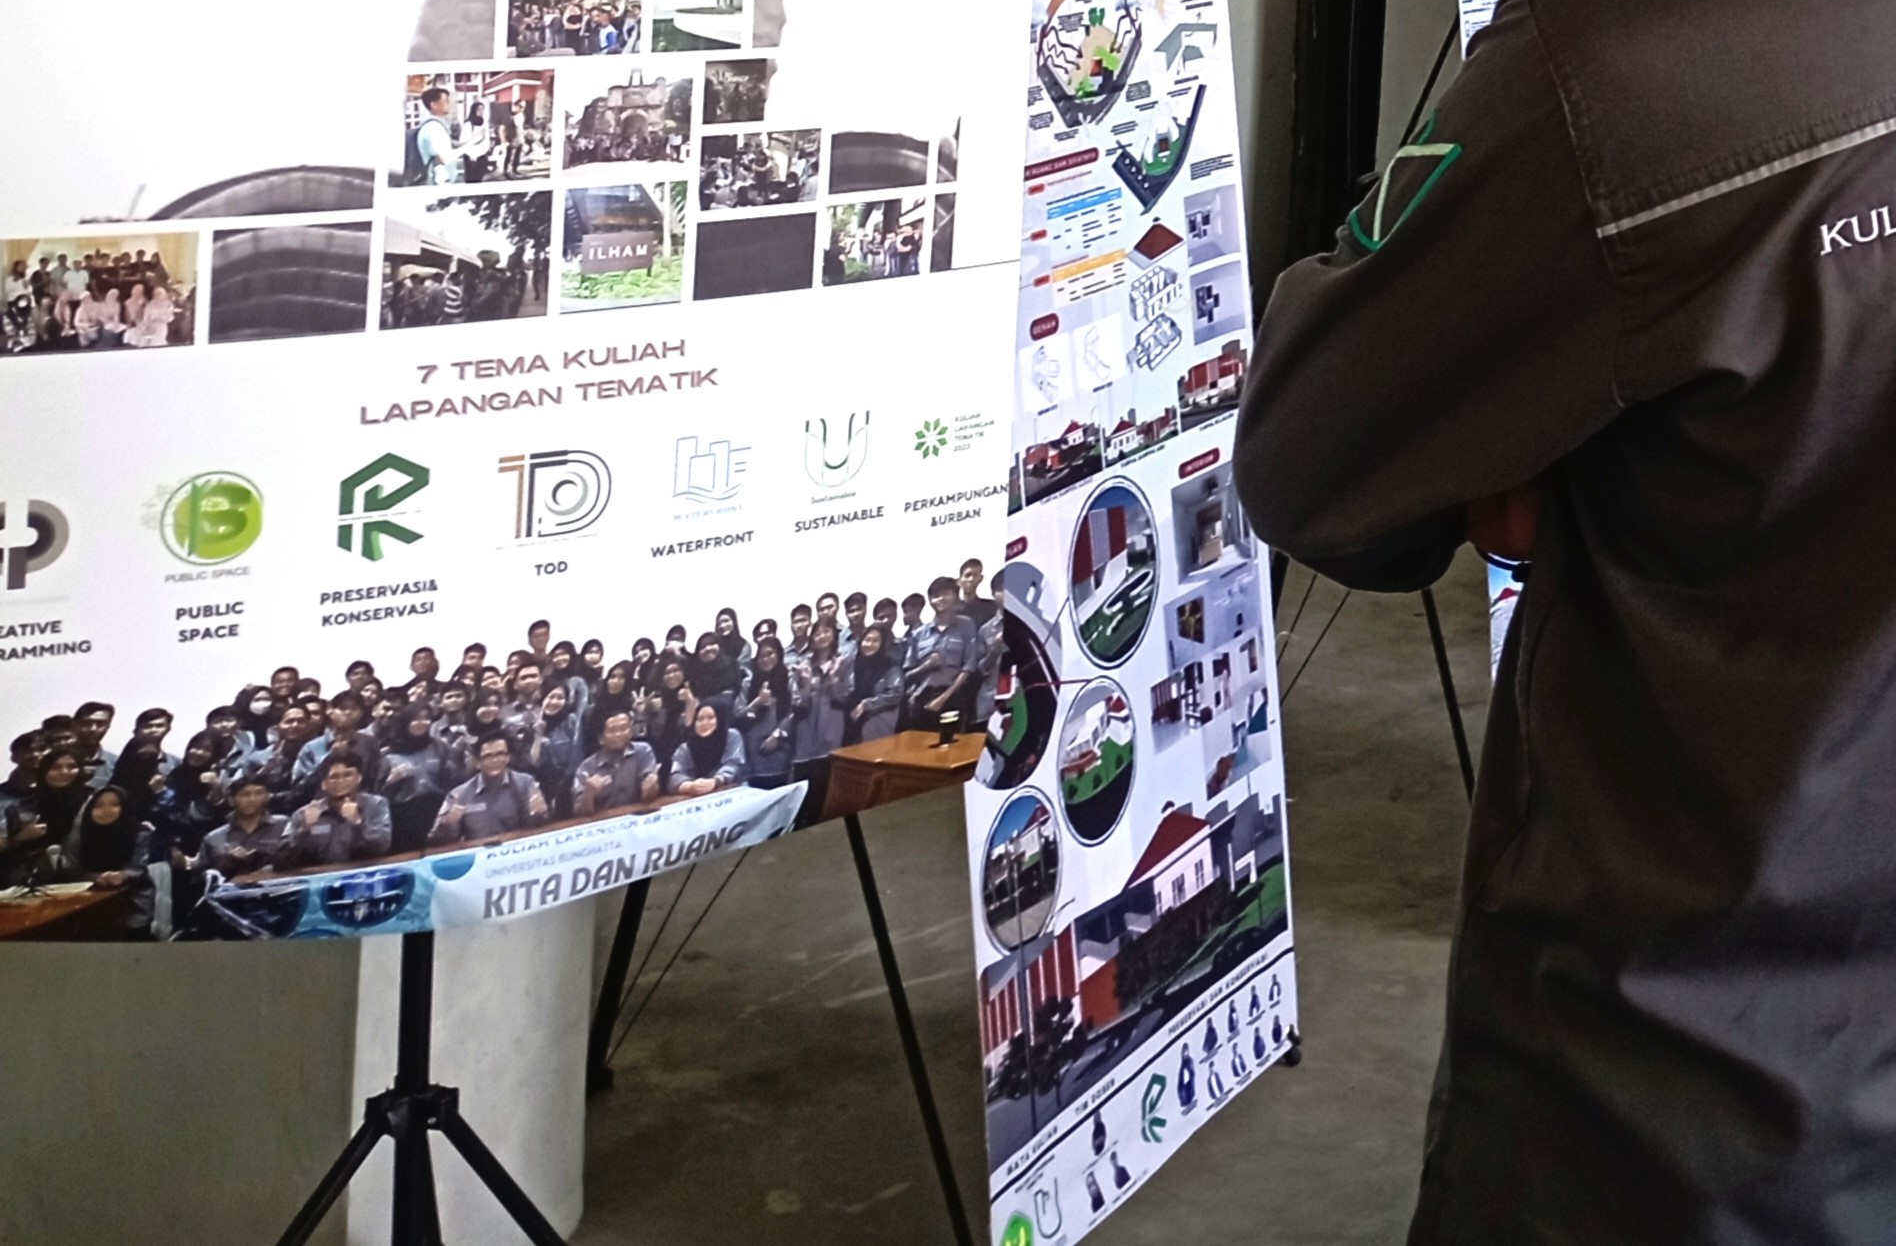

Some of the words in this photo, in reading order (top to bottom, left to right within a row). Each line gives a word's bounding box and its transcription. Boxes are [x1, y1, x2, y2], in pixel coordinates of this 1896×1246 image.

[588, 244, 648, 260] ILHAM
[415, 365, 438, 384] 7
[451, 354, 549, 382] TEMA
[562, 339, 687, 370] KULIAH
[359, 386, 563, 425] LAPANGAN
[575, 367, 719, 402] TEMATIK
[904, 481, 1009, 513] PERKAMPUNGAN
[795, 505, 885, 533] SUSTAINABLE
[650, 530, 754, 558] WATERFRONT
[164, 571, 207, 583] PUBLIC
[212, 566, 250, 579] SPACE
[534, 561, 568, 577] TOD
[320, 577, 438, 605] PRESERVASI&
[176, 601, 244, 621] PUBLIC
[322, 601, 435, 627] KONSERVASI
[178, 623, 239, 643] SPACE
[483, 872, 562, 919] KITA
[569, 853, 636, 897] DAN
[643, 820, 749, 875] RUANG
